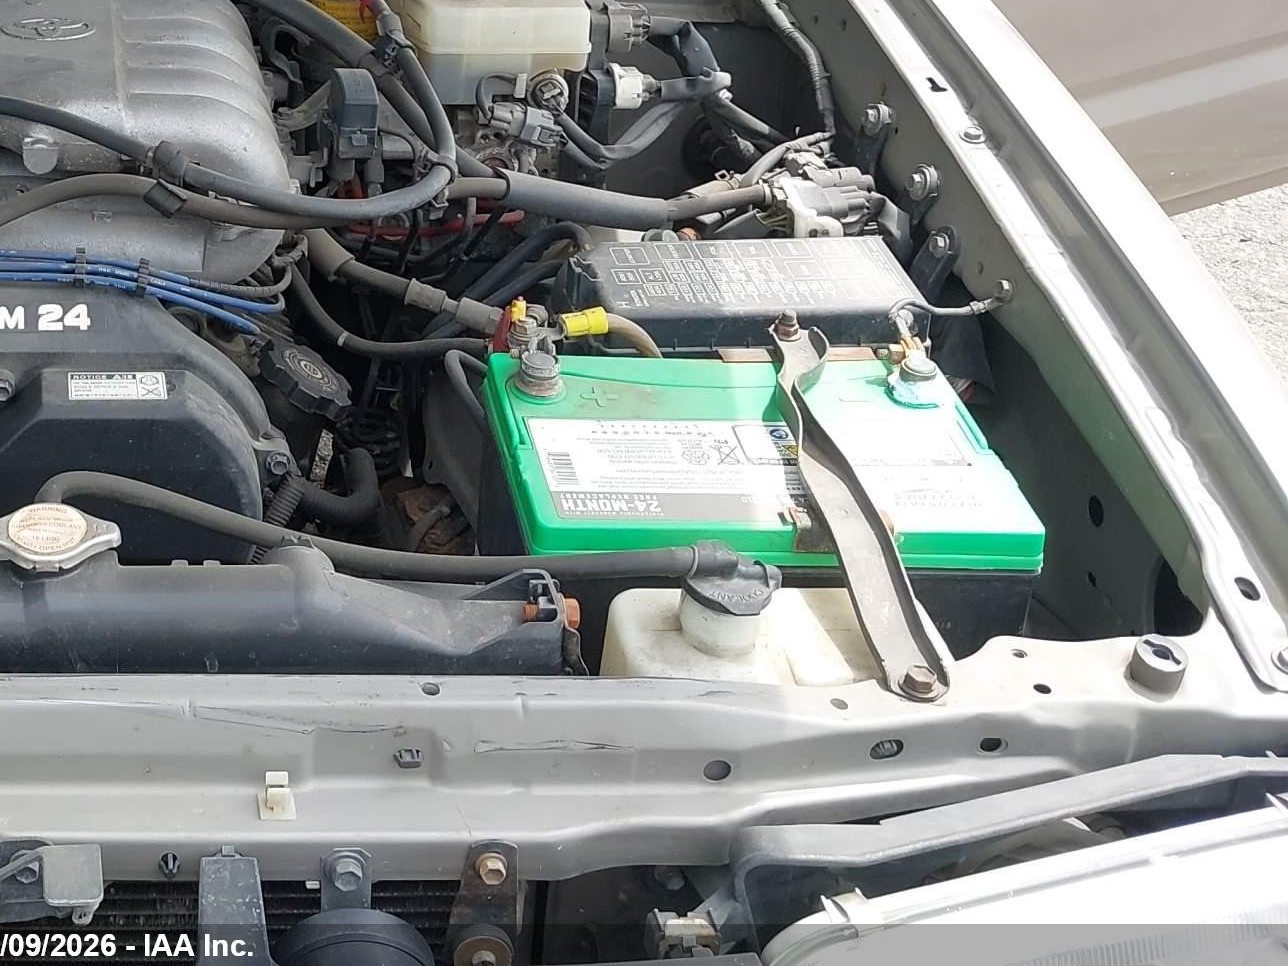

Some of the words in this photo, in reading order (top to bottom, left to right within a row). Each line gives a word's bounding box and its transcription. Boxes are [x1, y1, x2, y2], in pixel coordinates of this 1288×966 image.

[37, 303, 91, 332] 24
[559, 492, 629, 500] REPLACEMENT
[28, 505, 68, 514] WARNING
[560, 499, 662, 512] 24-MONTH
[708, 587, 765, 603] COOLANT
